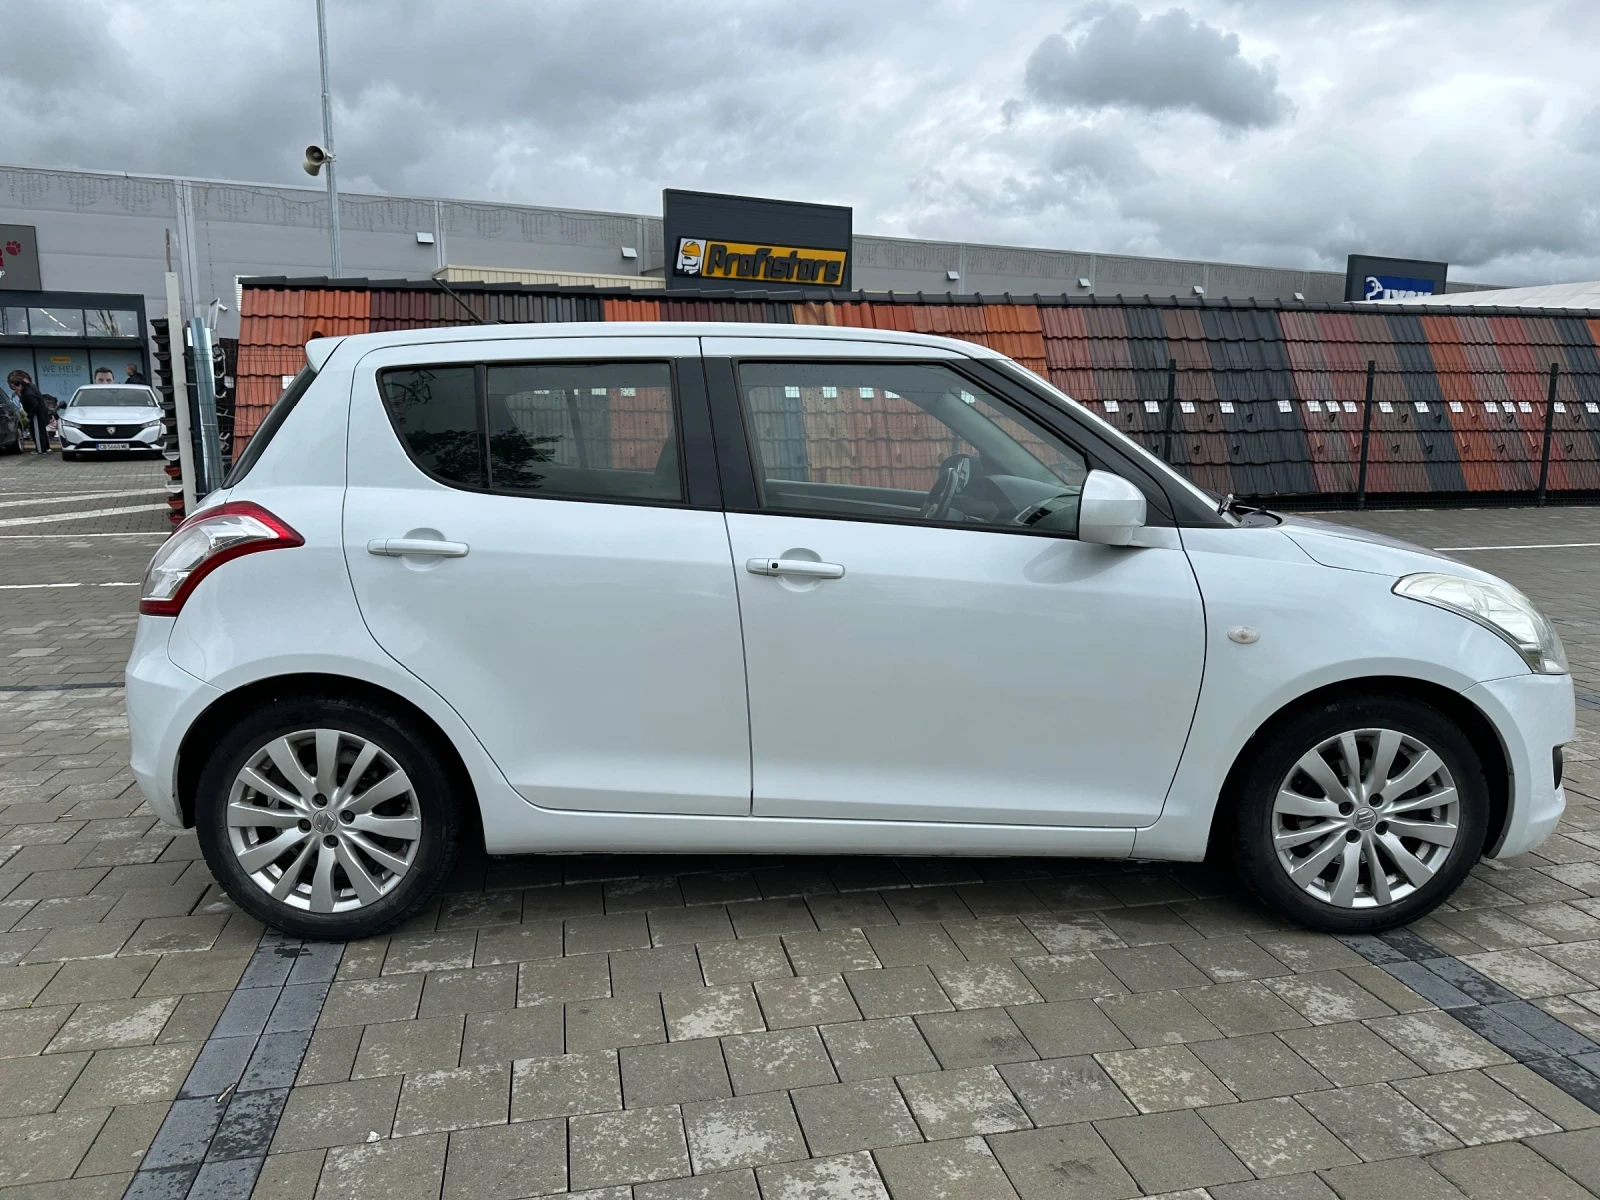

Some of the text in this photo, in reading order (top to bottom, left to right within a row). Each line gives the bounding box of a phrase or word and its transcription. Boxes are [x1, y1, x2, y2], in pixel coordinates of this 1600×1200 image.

[706, 243, 842, 283] Profistore
[41, 364, 82, 374] WE HELP
